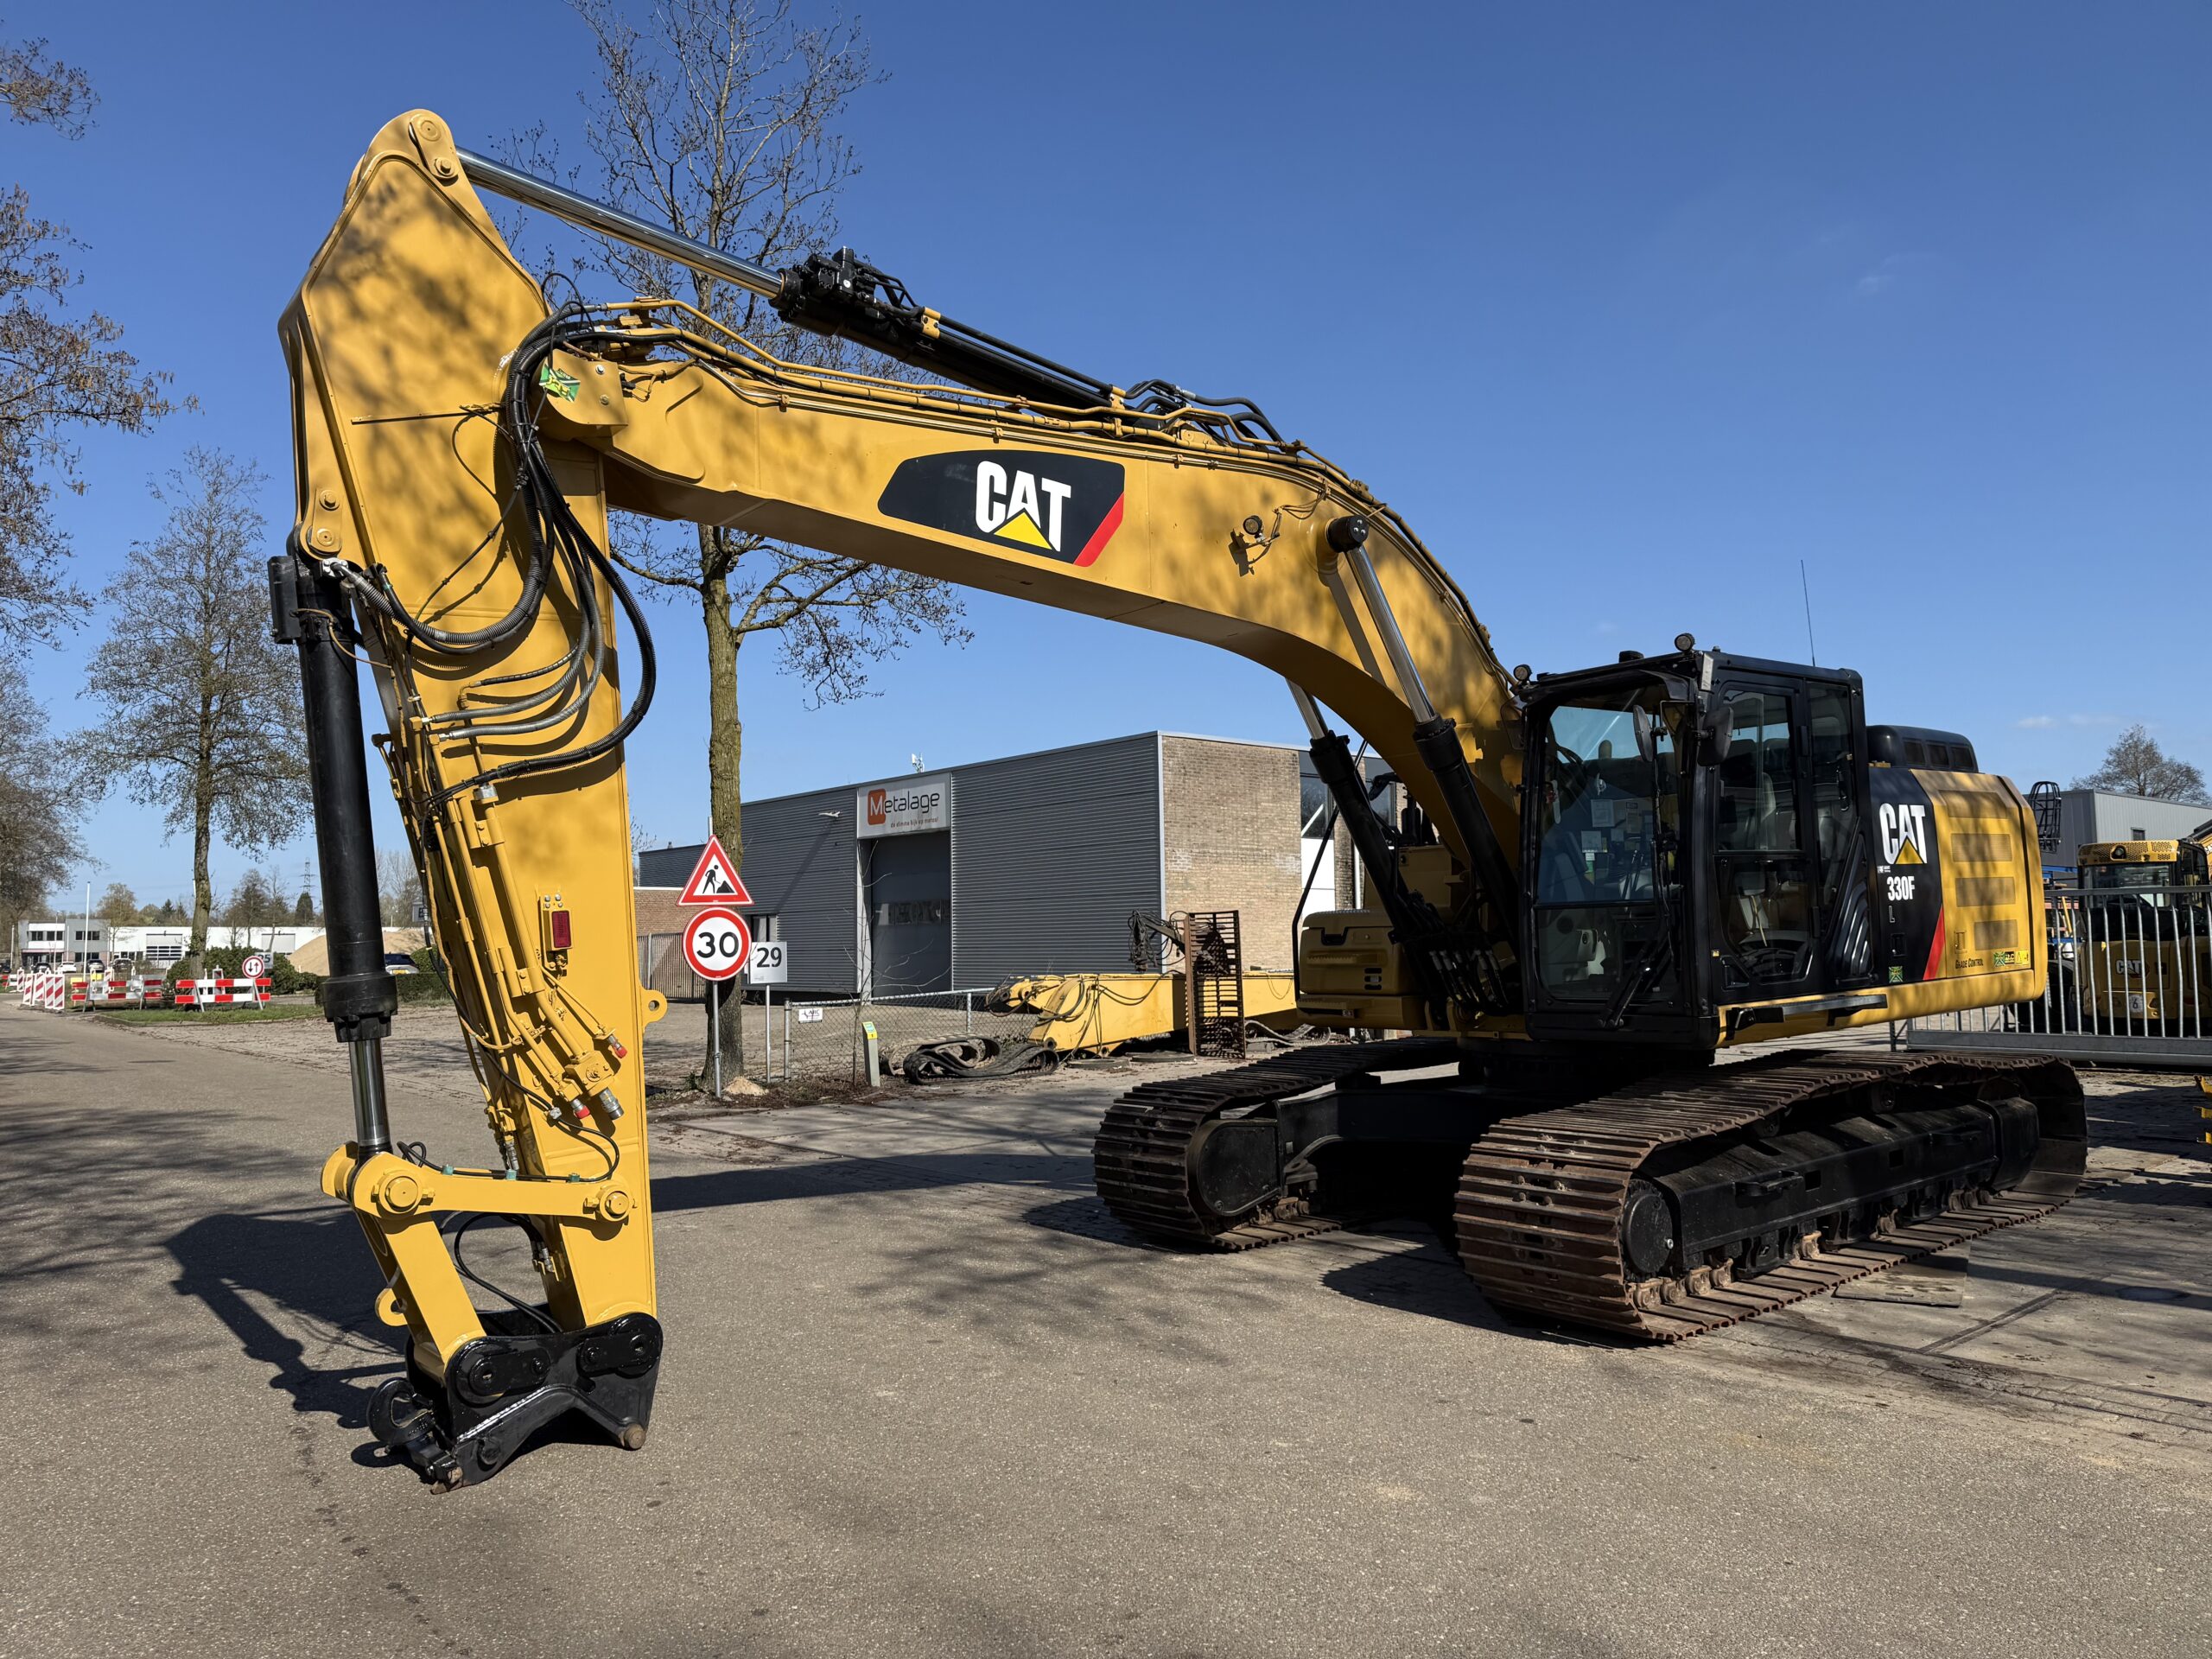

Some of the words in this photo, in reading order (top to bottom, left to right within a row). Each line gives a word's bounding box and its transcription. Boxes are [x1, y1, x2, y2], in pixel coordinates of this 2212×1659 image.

[976, 461, 1071, 552] CAT
[870, 790, 940, 817] Metalage
[1879, 803, 1928, 865] CAT
[1886, 875, 1915, 901] 330F
[1888, 905, 1896, 924] L
[696, 931, 740, 958] 30
[756, 946, 783, 968] 29
